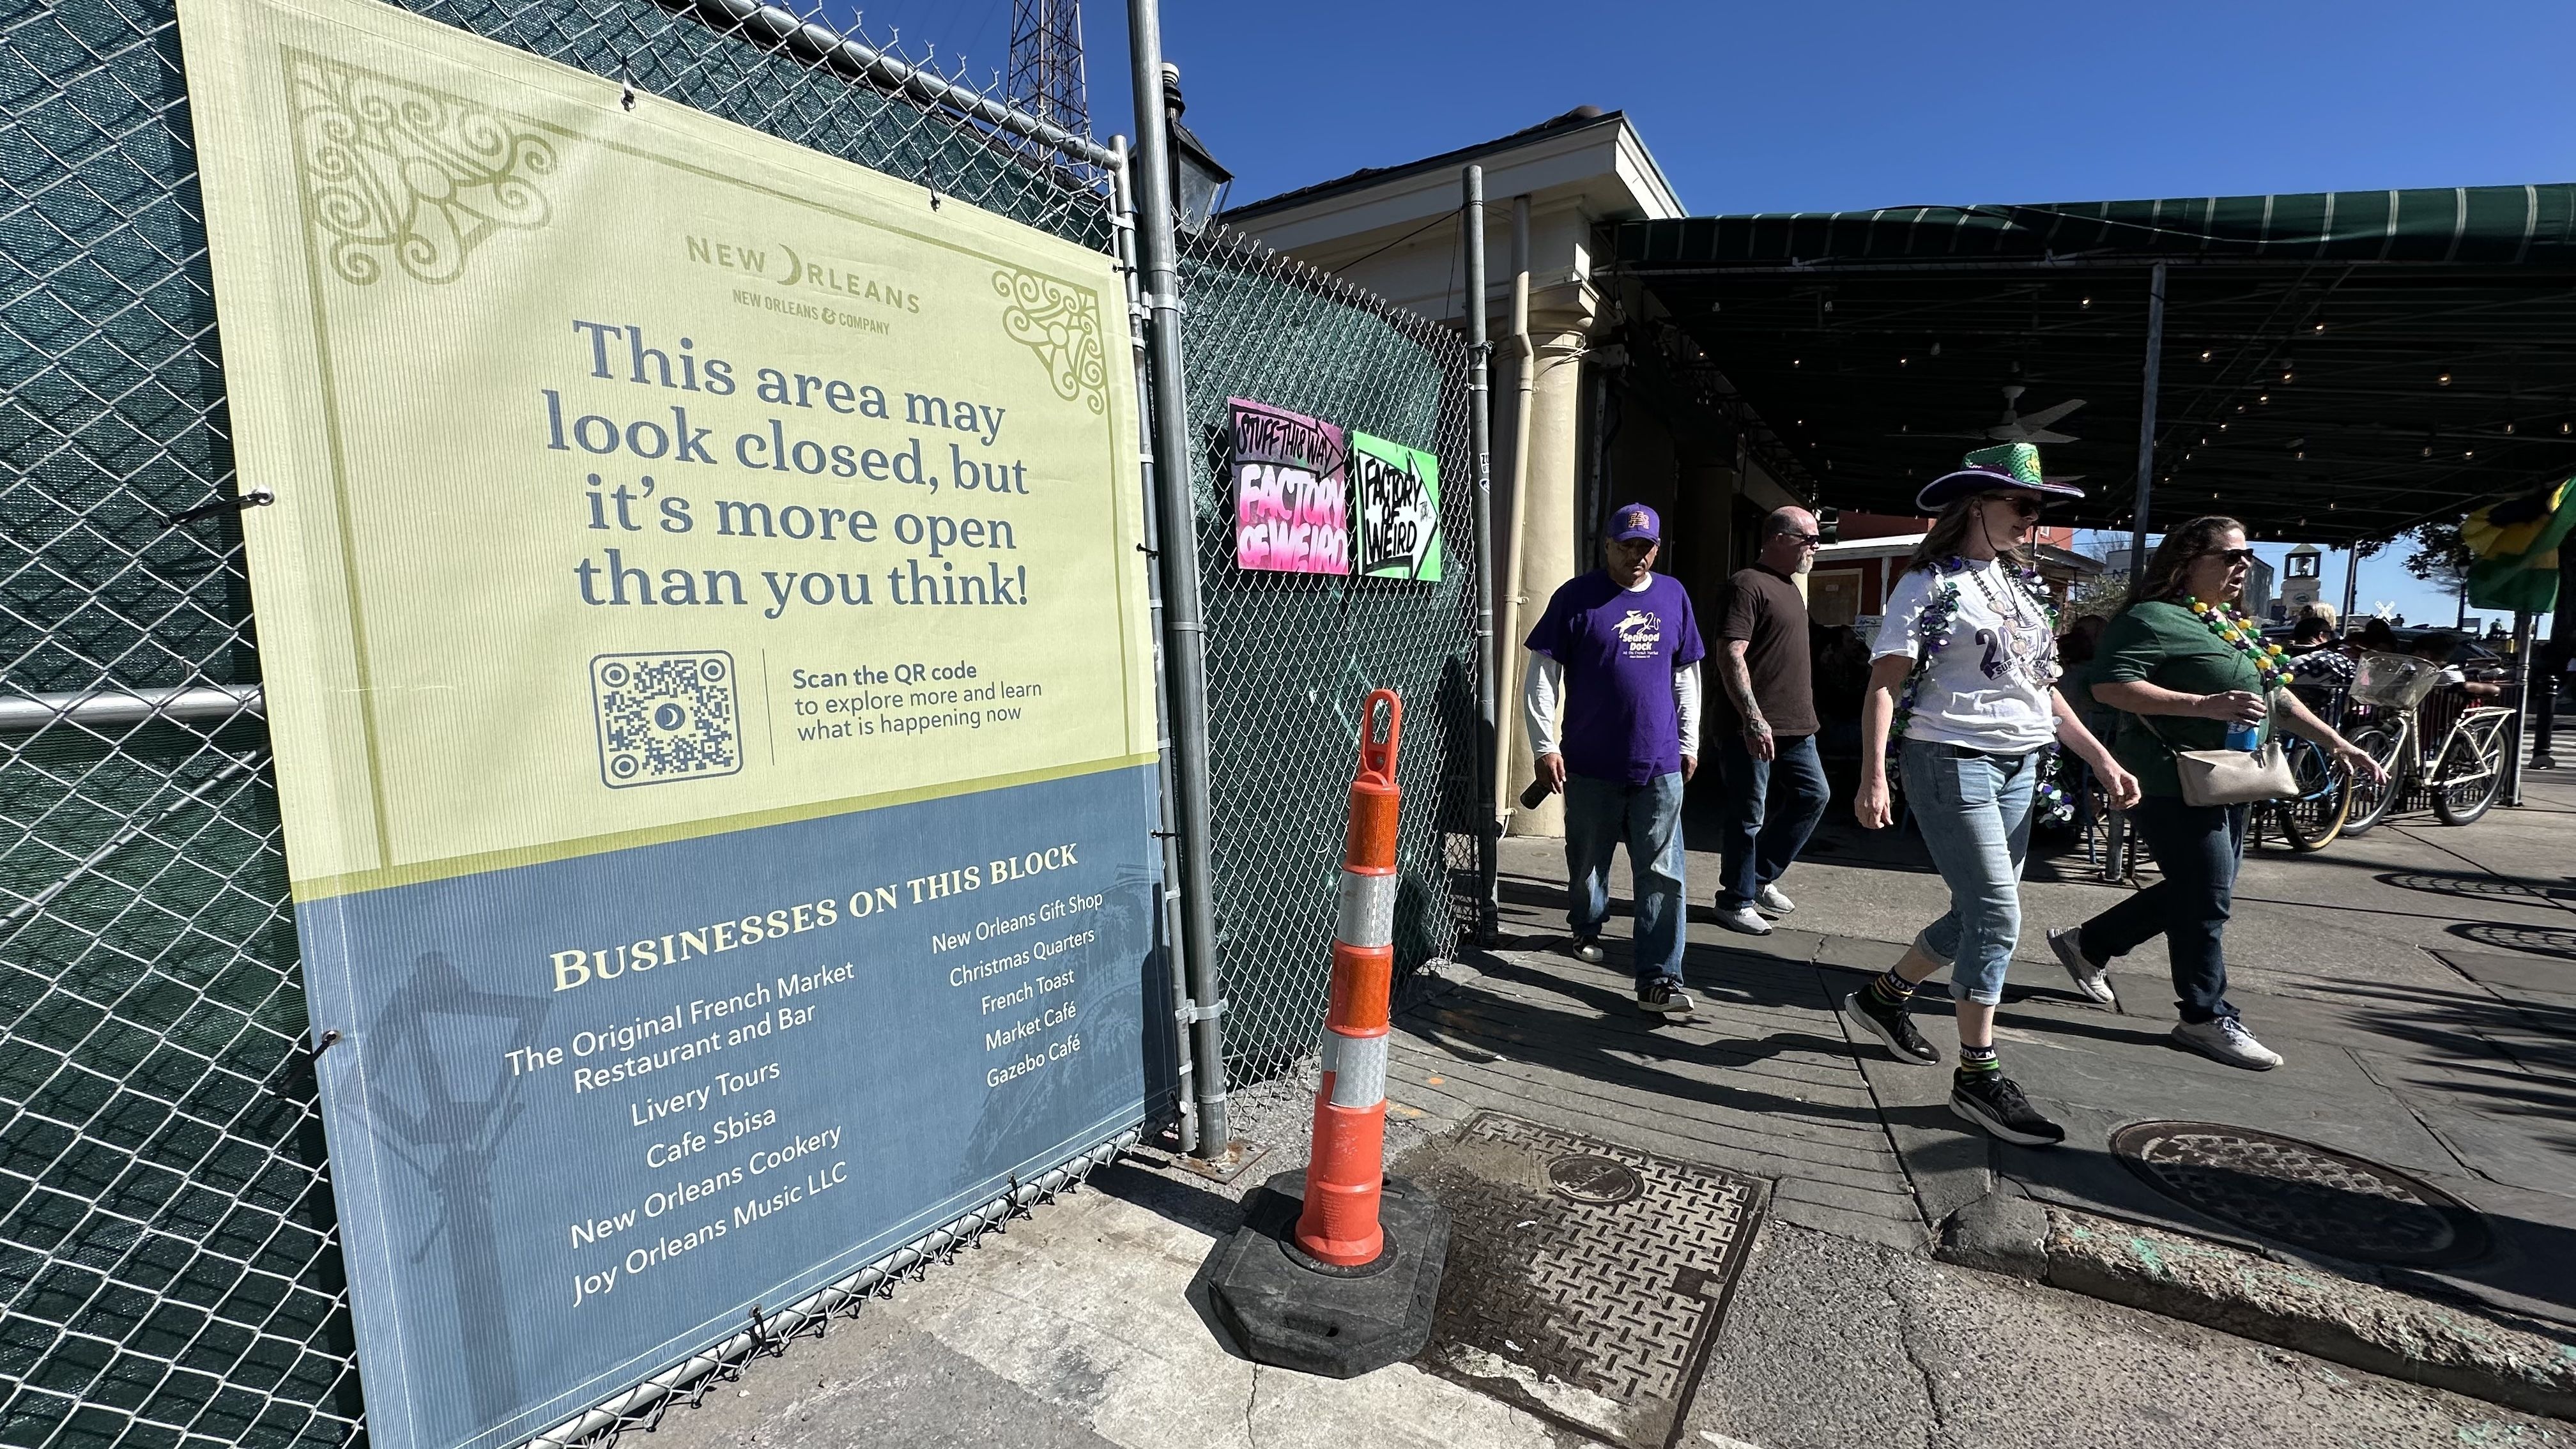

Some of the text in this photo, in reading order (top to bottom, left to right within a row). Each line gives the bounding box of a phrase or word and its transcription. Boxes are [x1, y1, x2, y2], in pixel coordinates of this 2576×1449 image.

[686, 235, 765, 273] NEW
[733, 289, 890, 335] NEW ORLEANS & COMPANY
[572, 320, 1006, 445] This area may
[541, 390, 1029, 495] look closed, but
[1236, 413, 1334, 475] STUFF THIS WAY
[1239, 464, 1346, 529] FACTORY
[1365, 457, 1423, 512] FACTORY
[1382, 500, 1400, 525] OF
[715, 499, 878, 542] more
[894, 514, 1016, 558] open
[1239, 518, 1348, 573] OF WEIRD
[1365, 518, 1418, 563] WEIRD
[574, 548, 1027, 620] than you think!
[793, 660, 977, 689] Scan the QR code
[795, 680, 1042, 717] to explore more and learn
[797, 706, 1022, 741] what is happening now
[549, 842, 1078, 992] BUSINESSES ON THIS BLOCK
[932, 893, 1103, 954] New Orleans Gift Shop
[949, 930, 1095, 986] Christmas Quarters
[505, 962, 854, 1076] The Original French Market
[981, 969, 1075, 1015] French Toast
[574, 1004, 816, 1094] Restaurant and Bar
[986, 1000, 1077, 1052] Market Café
[986, 1033, 1080, 1087] Gazebo Café
[631, 1062, 781, 1126] Livery Tours
[646, 1108, 776, 1169] Cafe Sbisa
[571, 1126, 841, 1249] New Orleans Cookery
[573, 1161, 848, 1307] Joy Orleans Music LLC
